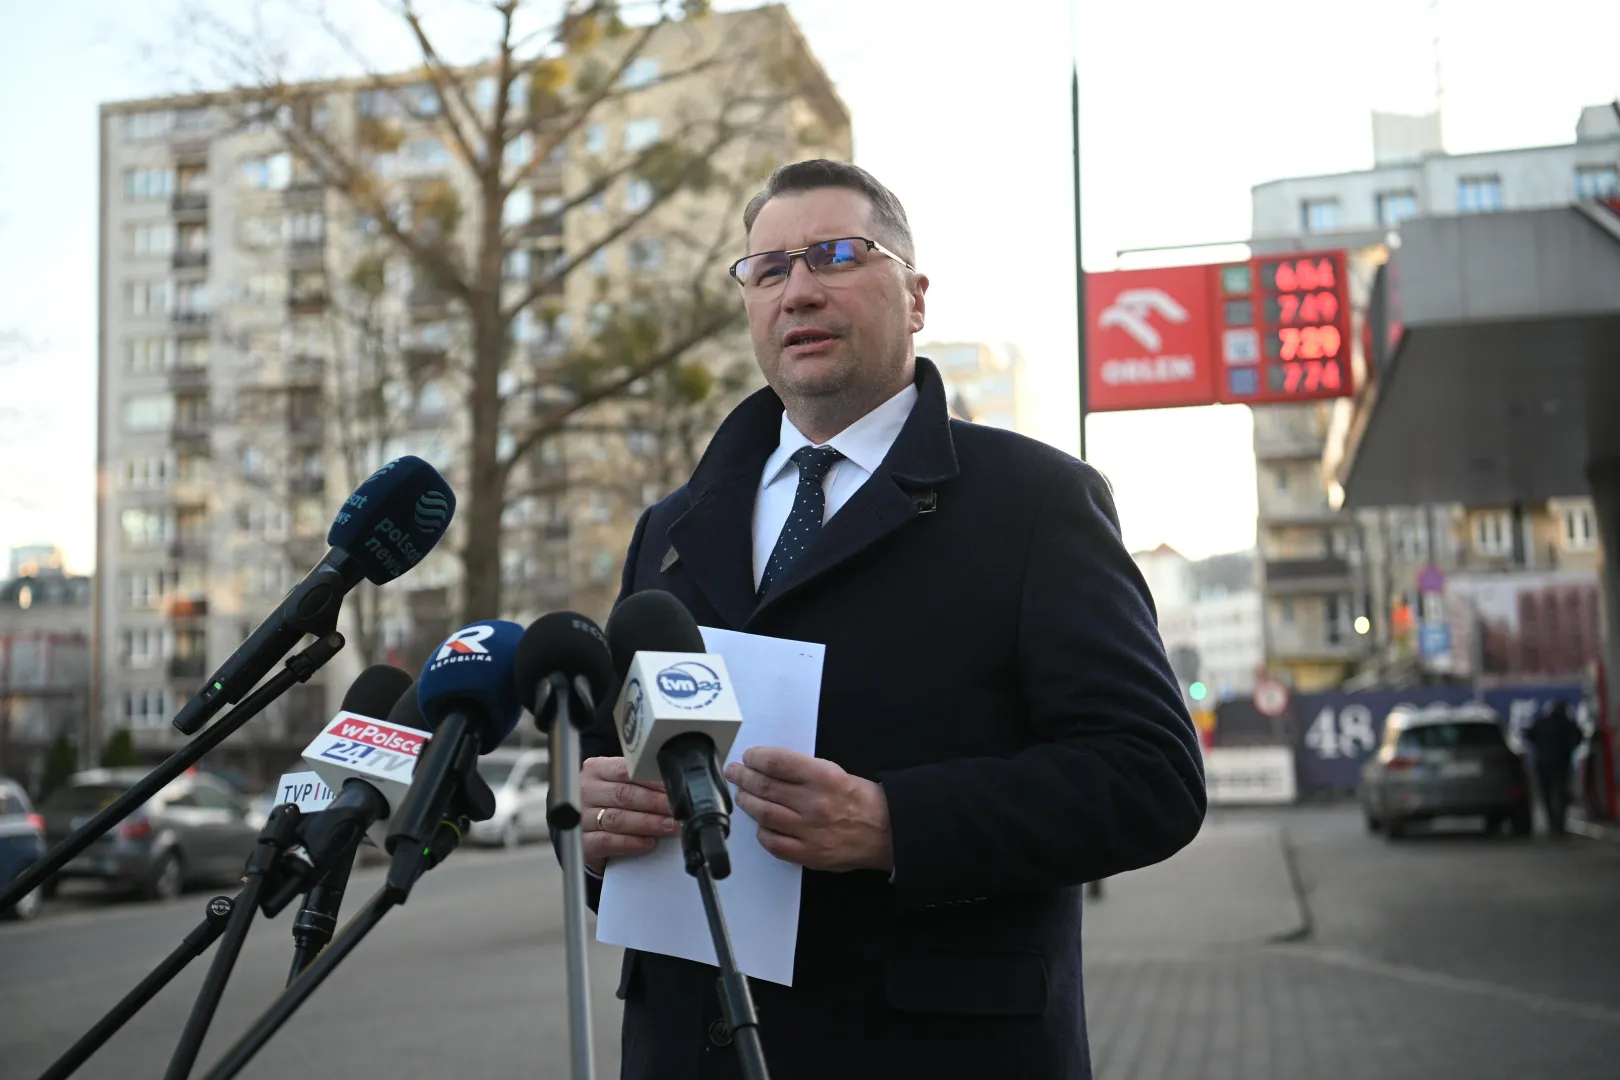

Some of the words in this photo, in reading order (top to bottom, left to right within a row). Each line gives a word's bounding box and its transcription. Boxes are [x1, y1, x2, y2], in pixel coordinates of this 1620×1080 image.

[365, 536, 402, 577] news
[430, 654, 492, 671] REPUBLIKA
[340, 722, 422, 755] wPolsce
[284, 783, 313, 803] TVP
